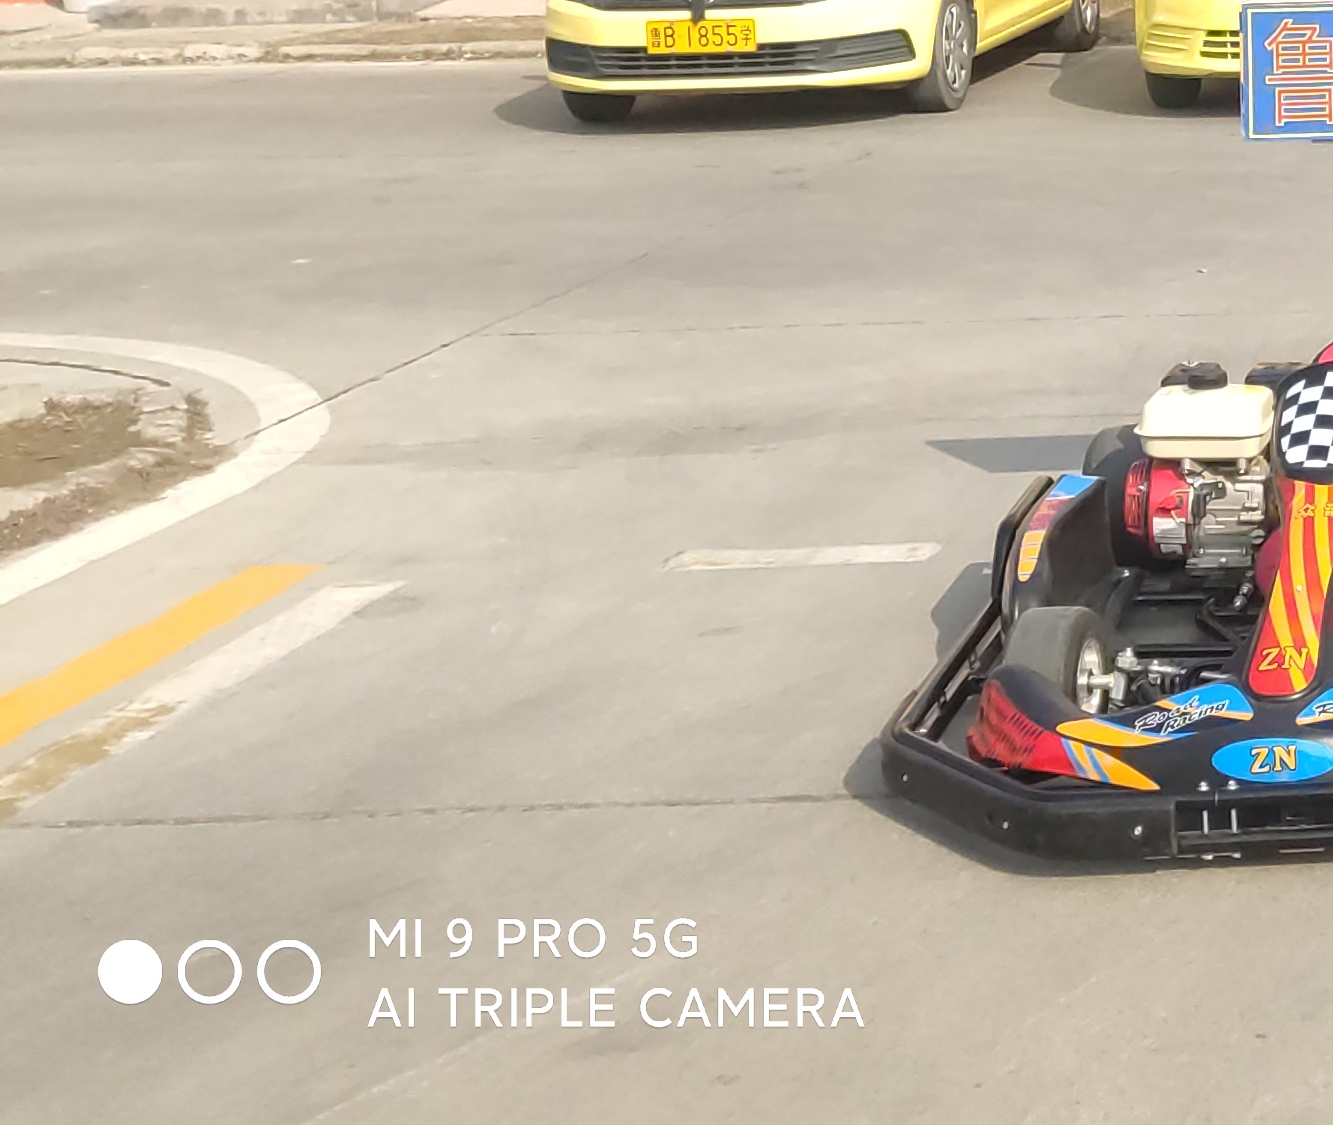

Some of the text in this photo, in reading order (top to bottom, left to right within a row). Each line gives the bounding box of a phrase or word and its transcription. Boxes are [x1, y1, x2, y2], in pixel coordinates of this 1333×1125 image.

[1258, 645, 1309, 672] ZN
[1161, 699, 1229, 736] Racing
[1250, 745, 1297, 774] ZN
